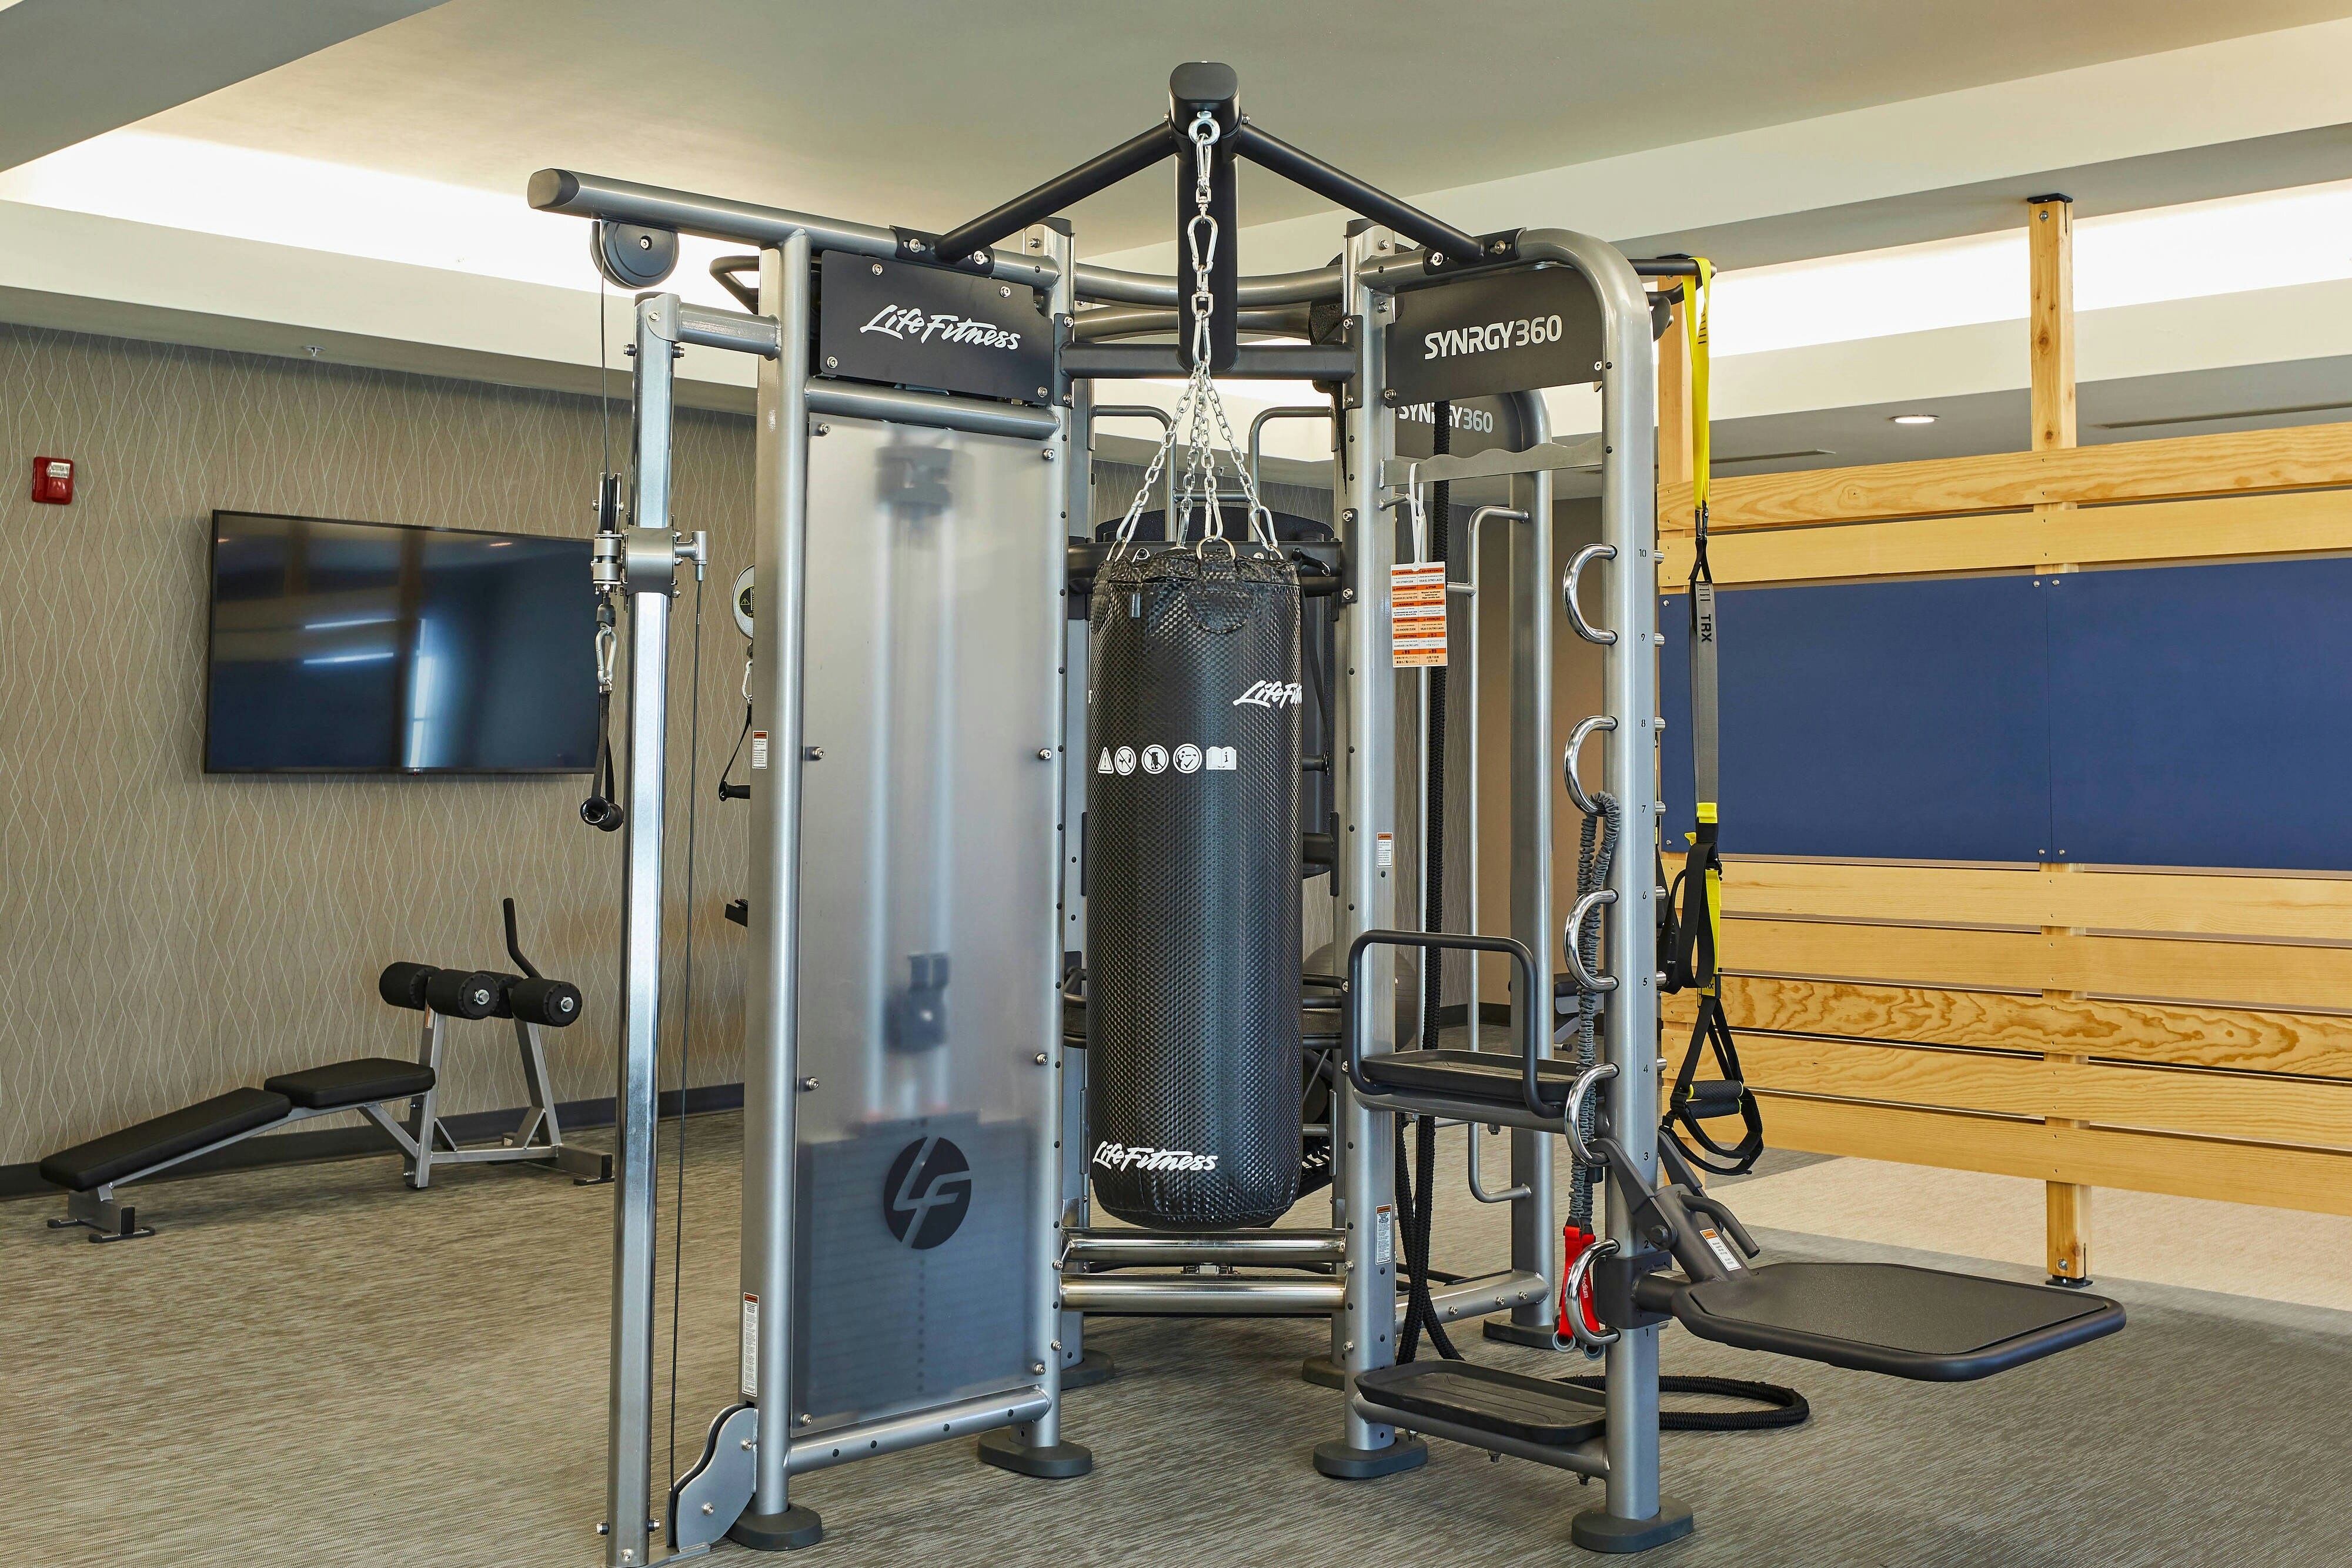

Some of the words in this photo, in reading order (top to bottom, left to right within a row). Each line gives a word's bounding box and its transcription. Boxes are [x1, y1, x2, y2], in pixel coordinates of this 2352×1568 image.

[1425, 315, 1562, 360] SYNRGY360
[1639, 549, 1647, 558] 10
[1700, 613, 1713, 643] TRX
[1641, 633, 1646, 641] 9
[1641, 719, 1646, 728] 8
[1641, 804, 1646, 814] 7
[1642, 891, 1647, 900] 6
[1642, 977, 1648, 987] 5
[1643, 1064, 1648, 1074] 4
[1643, 1152, 1649, 1161] 3
[1644, 1240, 1649, 1249] 2
[1645, 1328, 1649, 1337] 1
